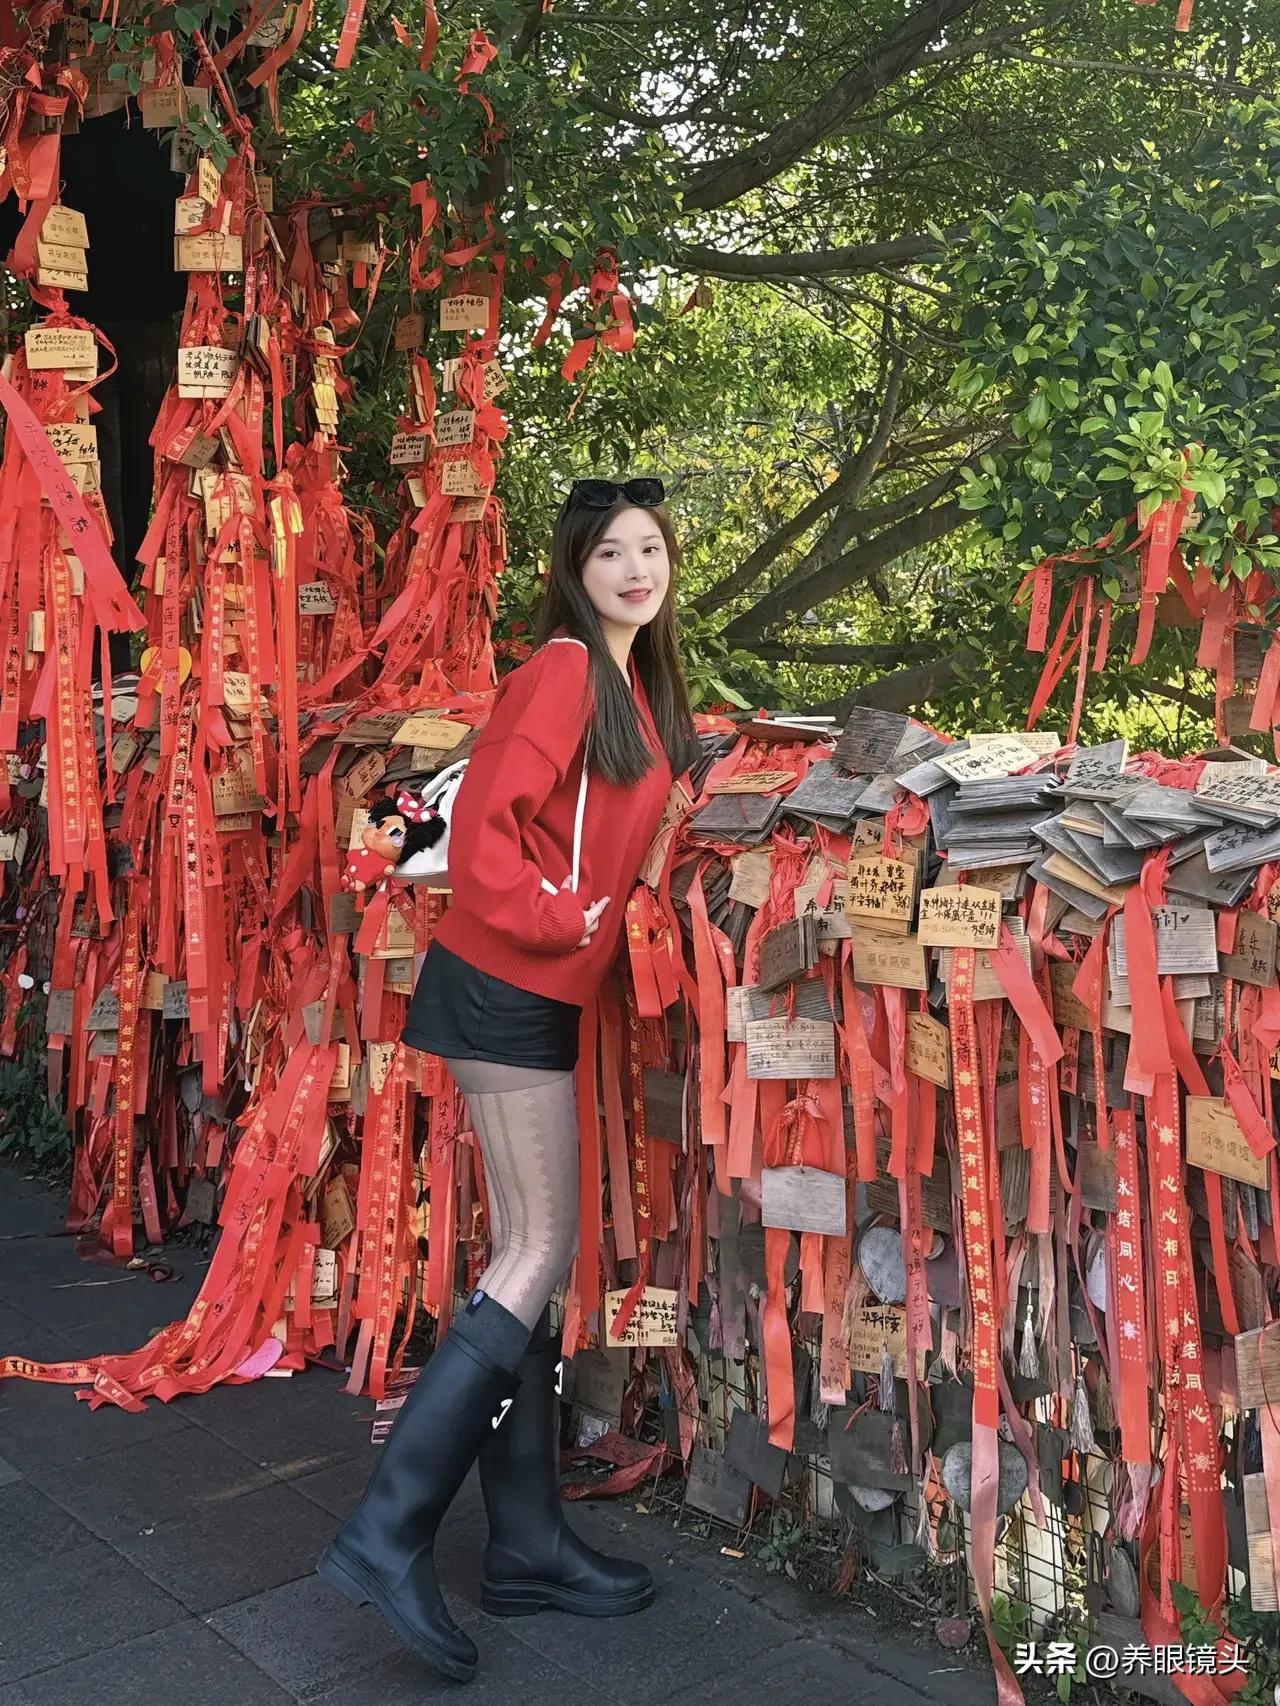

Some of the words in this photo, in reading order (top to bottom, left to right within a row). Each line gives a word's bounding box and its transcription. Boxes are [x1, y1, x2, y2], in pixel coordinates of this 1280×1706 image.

[961, 1106, 980, 1191] 学业有成
[1117, 1177, 1136, 1293] 永结同心
[969, 1241, 992, 1326] 金榜题名
